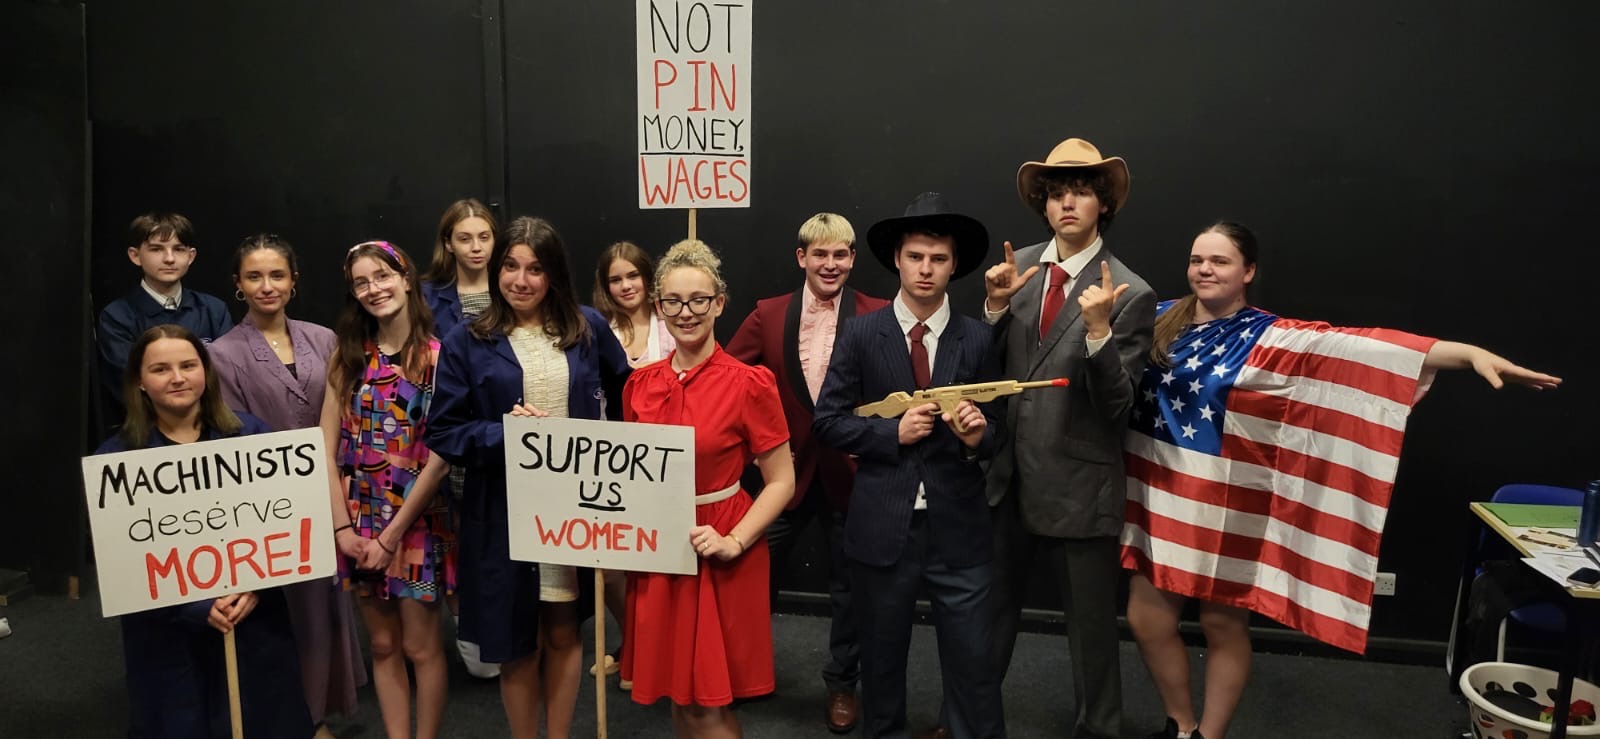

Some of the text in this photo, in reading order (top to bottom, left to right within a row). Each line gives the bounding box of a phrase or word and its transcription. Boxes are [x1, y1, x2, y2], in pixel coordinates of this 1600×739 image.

[650, 0, 744, 54] NOT
[654, 59, 737, 112] PIN
[643, 114, 744, 152] MONEY,
[641, 156, 748, 206] WAGES
[98, 443, 317, 509] MACHINISTS
[519, 431, 685, 483] SUPPORT
[579, 480, 622, 507] US
[128, 497, 293, 543] deserve
[534, 515, 658, 553] WOMEN
[145, 517, 312, 601] MORE!
